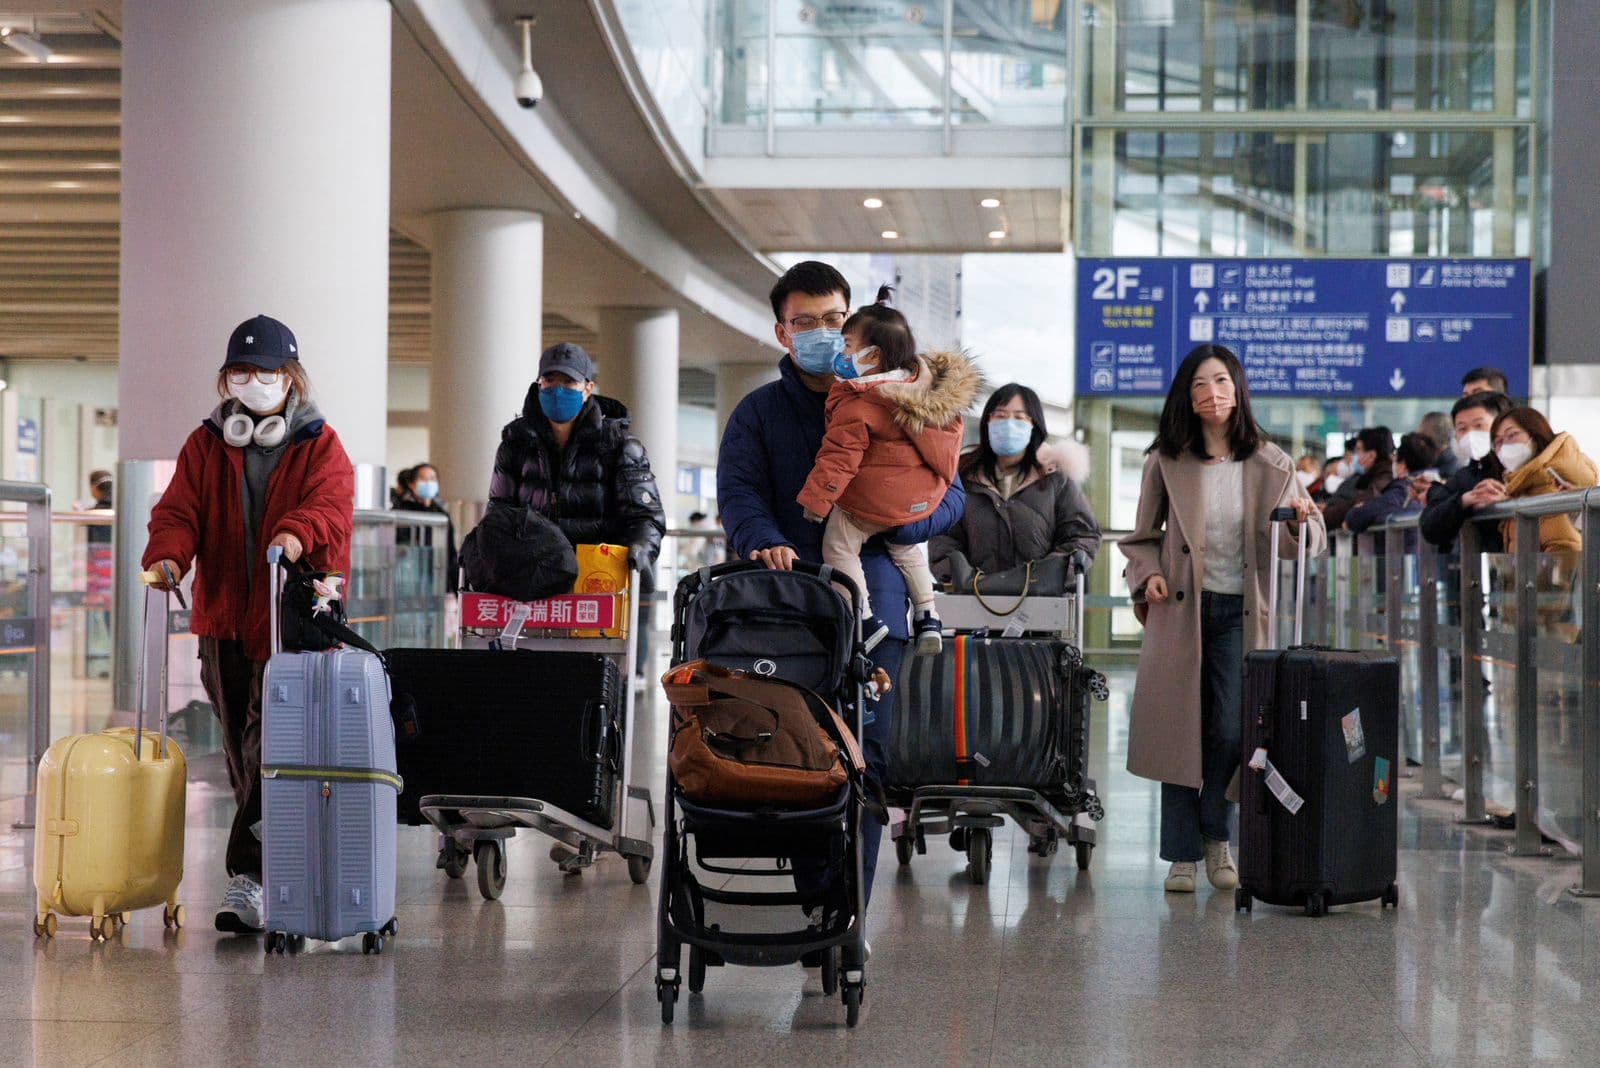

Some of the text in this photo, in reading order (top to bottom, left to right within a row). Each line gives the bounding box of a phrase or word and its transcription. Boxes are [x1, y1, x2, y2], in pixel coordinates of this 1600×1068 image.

[1092, 266, 1141, 300] 2F
[1245, 277, 1315, 289] Departure Hall
[1441, 278, 1508, 288] Airline Offices
[1442, 332, 1461, 342] Taxi
[1317, 356, 1355, 366] Terminal
